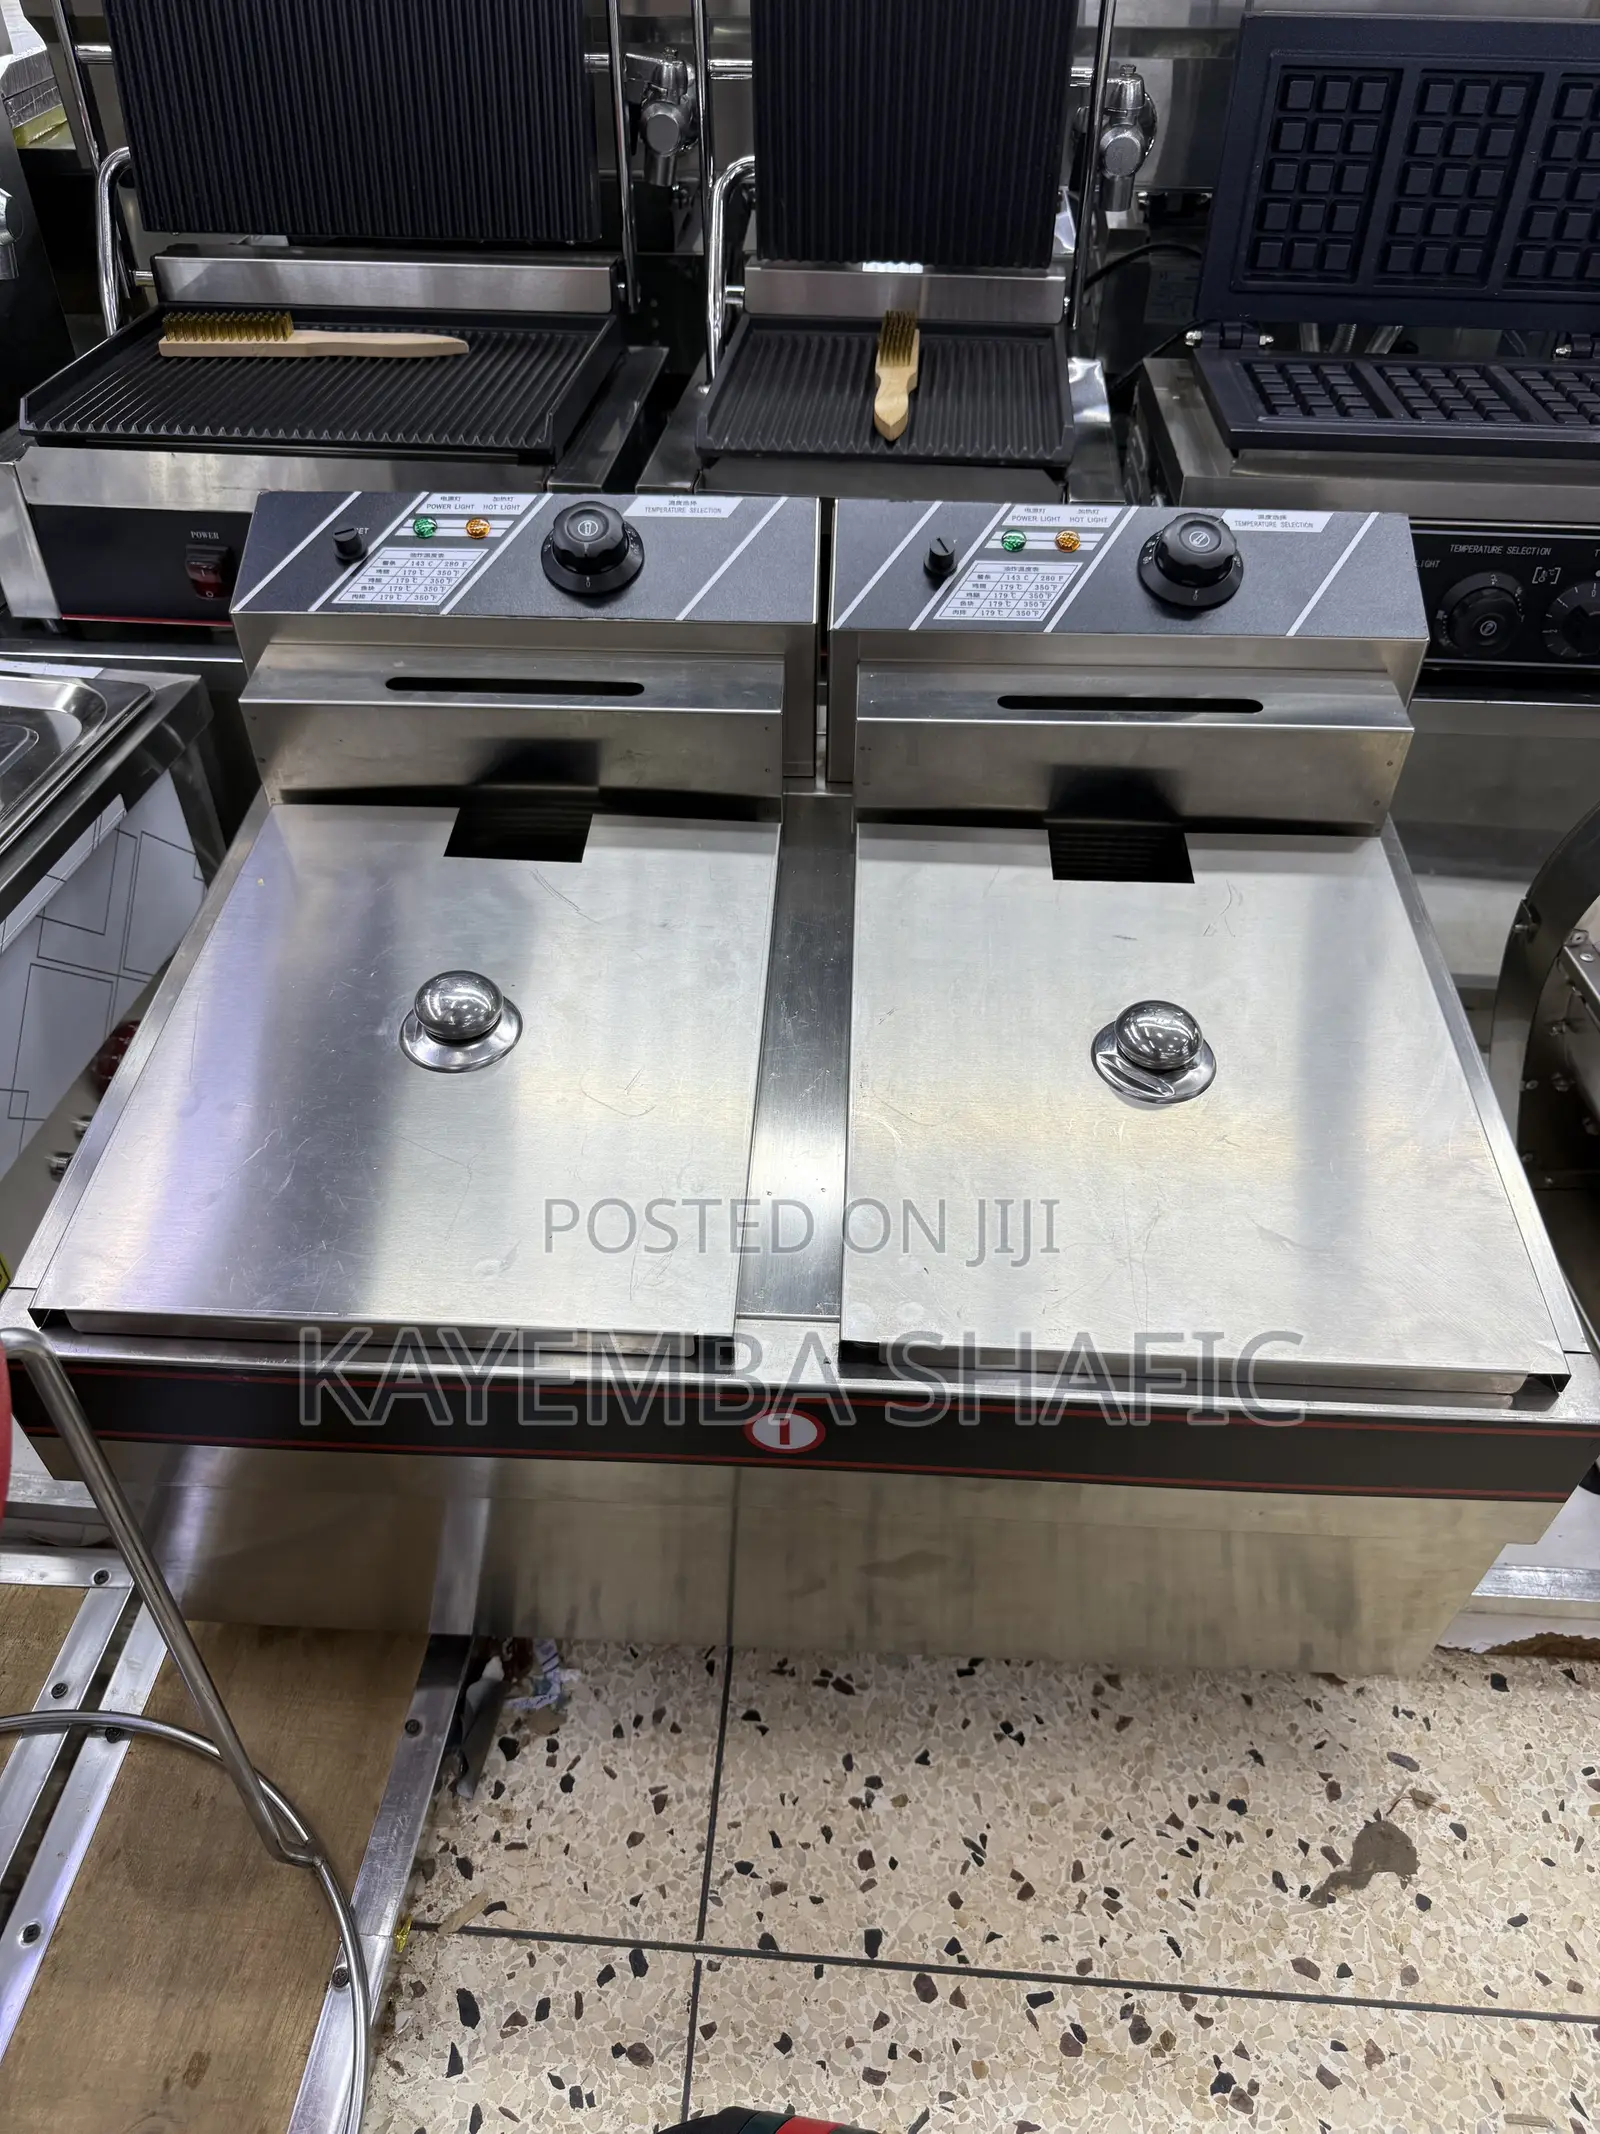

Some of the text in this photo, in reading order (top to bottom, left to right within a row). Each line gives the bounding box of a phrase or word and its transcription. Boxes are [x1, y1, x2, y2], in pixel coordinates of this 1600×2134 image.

[1234, 520, 1277, 528] TEMPERATURE
[190, 530, 220, 540] POWER
[1450, 544, 1552, 556] TEMPERATURE SELECTION
